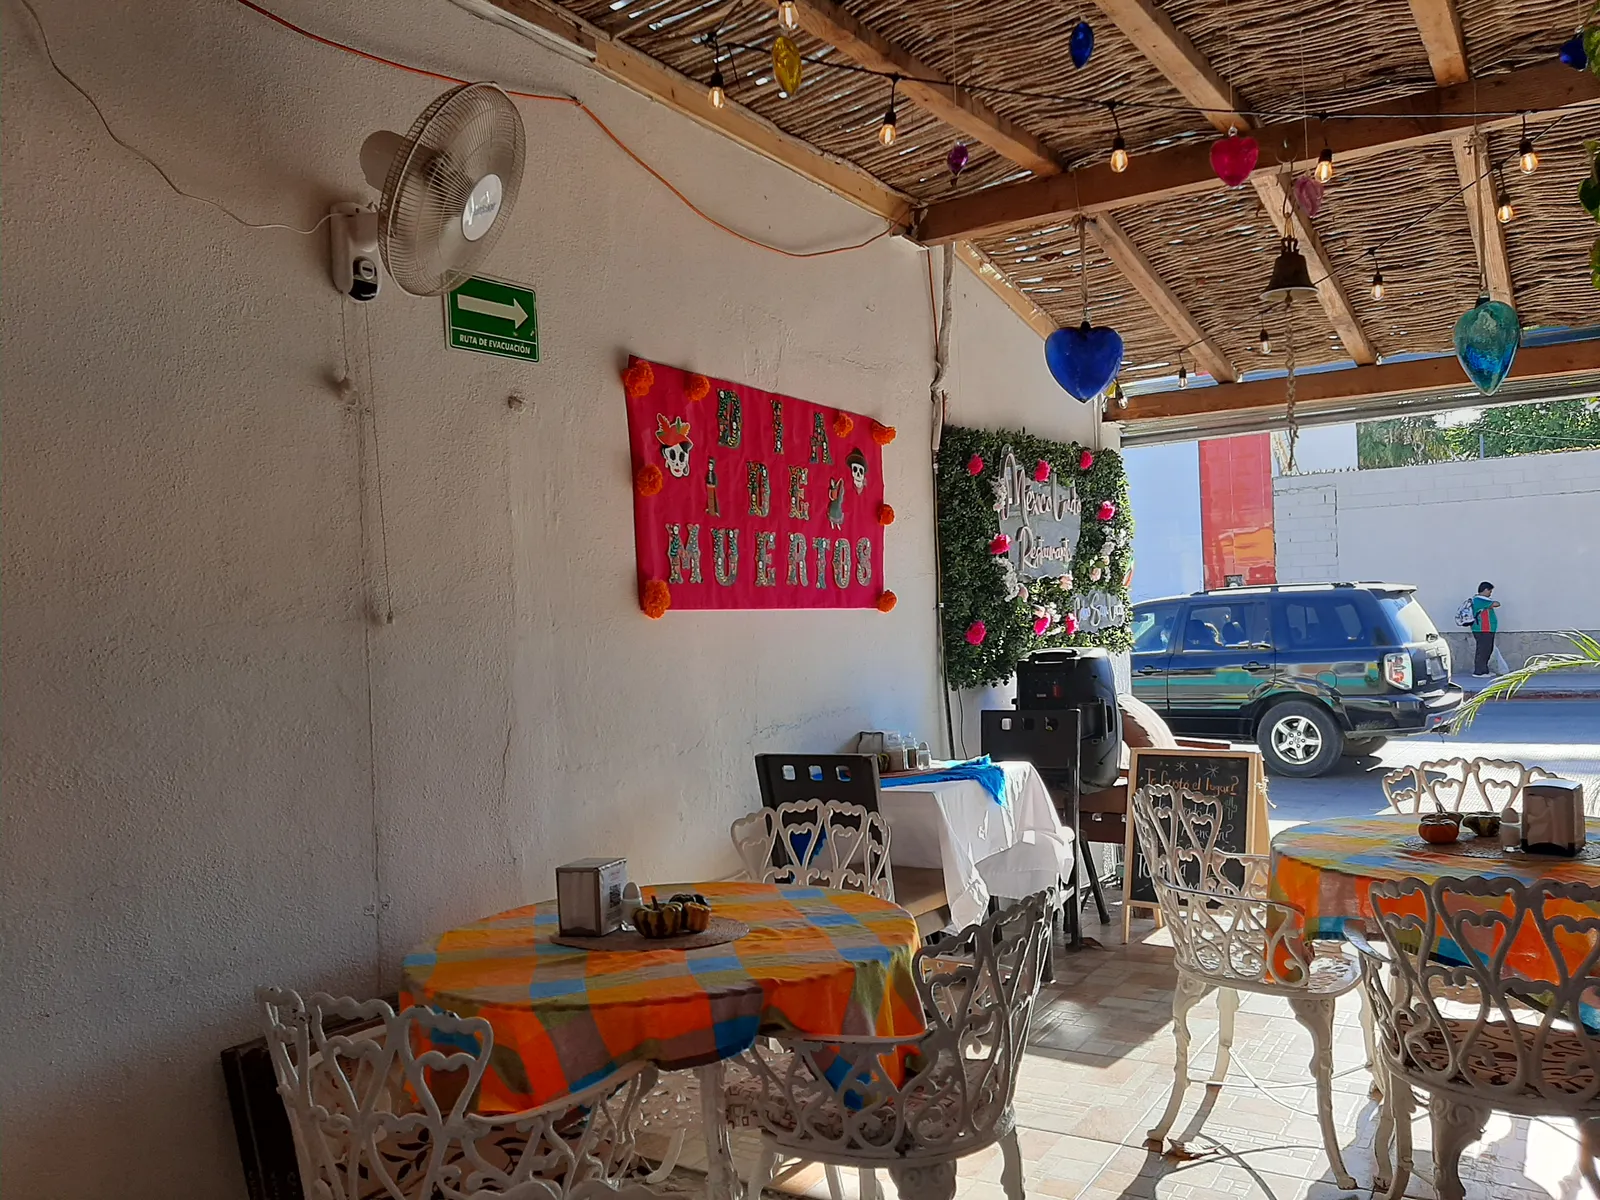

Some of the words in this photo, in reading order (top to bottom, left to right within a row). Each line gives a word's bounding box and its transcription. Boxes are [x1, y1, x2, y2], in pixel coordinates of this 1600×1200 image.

[459, 334, 478, 345] RUTA
[479, 338, 488, 347] DE
[488, 340, 531, 355] EVACUACIÓN
[717, 388, 833, 465] DIA
[746, 461, 810, 521] DE
[665, 523, 873, 589] MUERTOS
[1192, 777, 1202, 791] el
